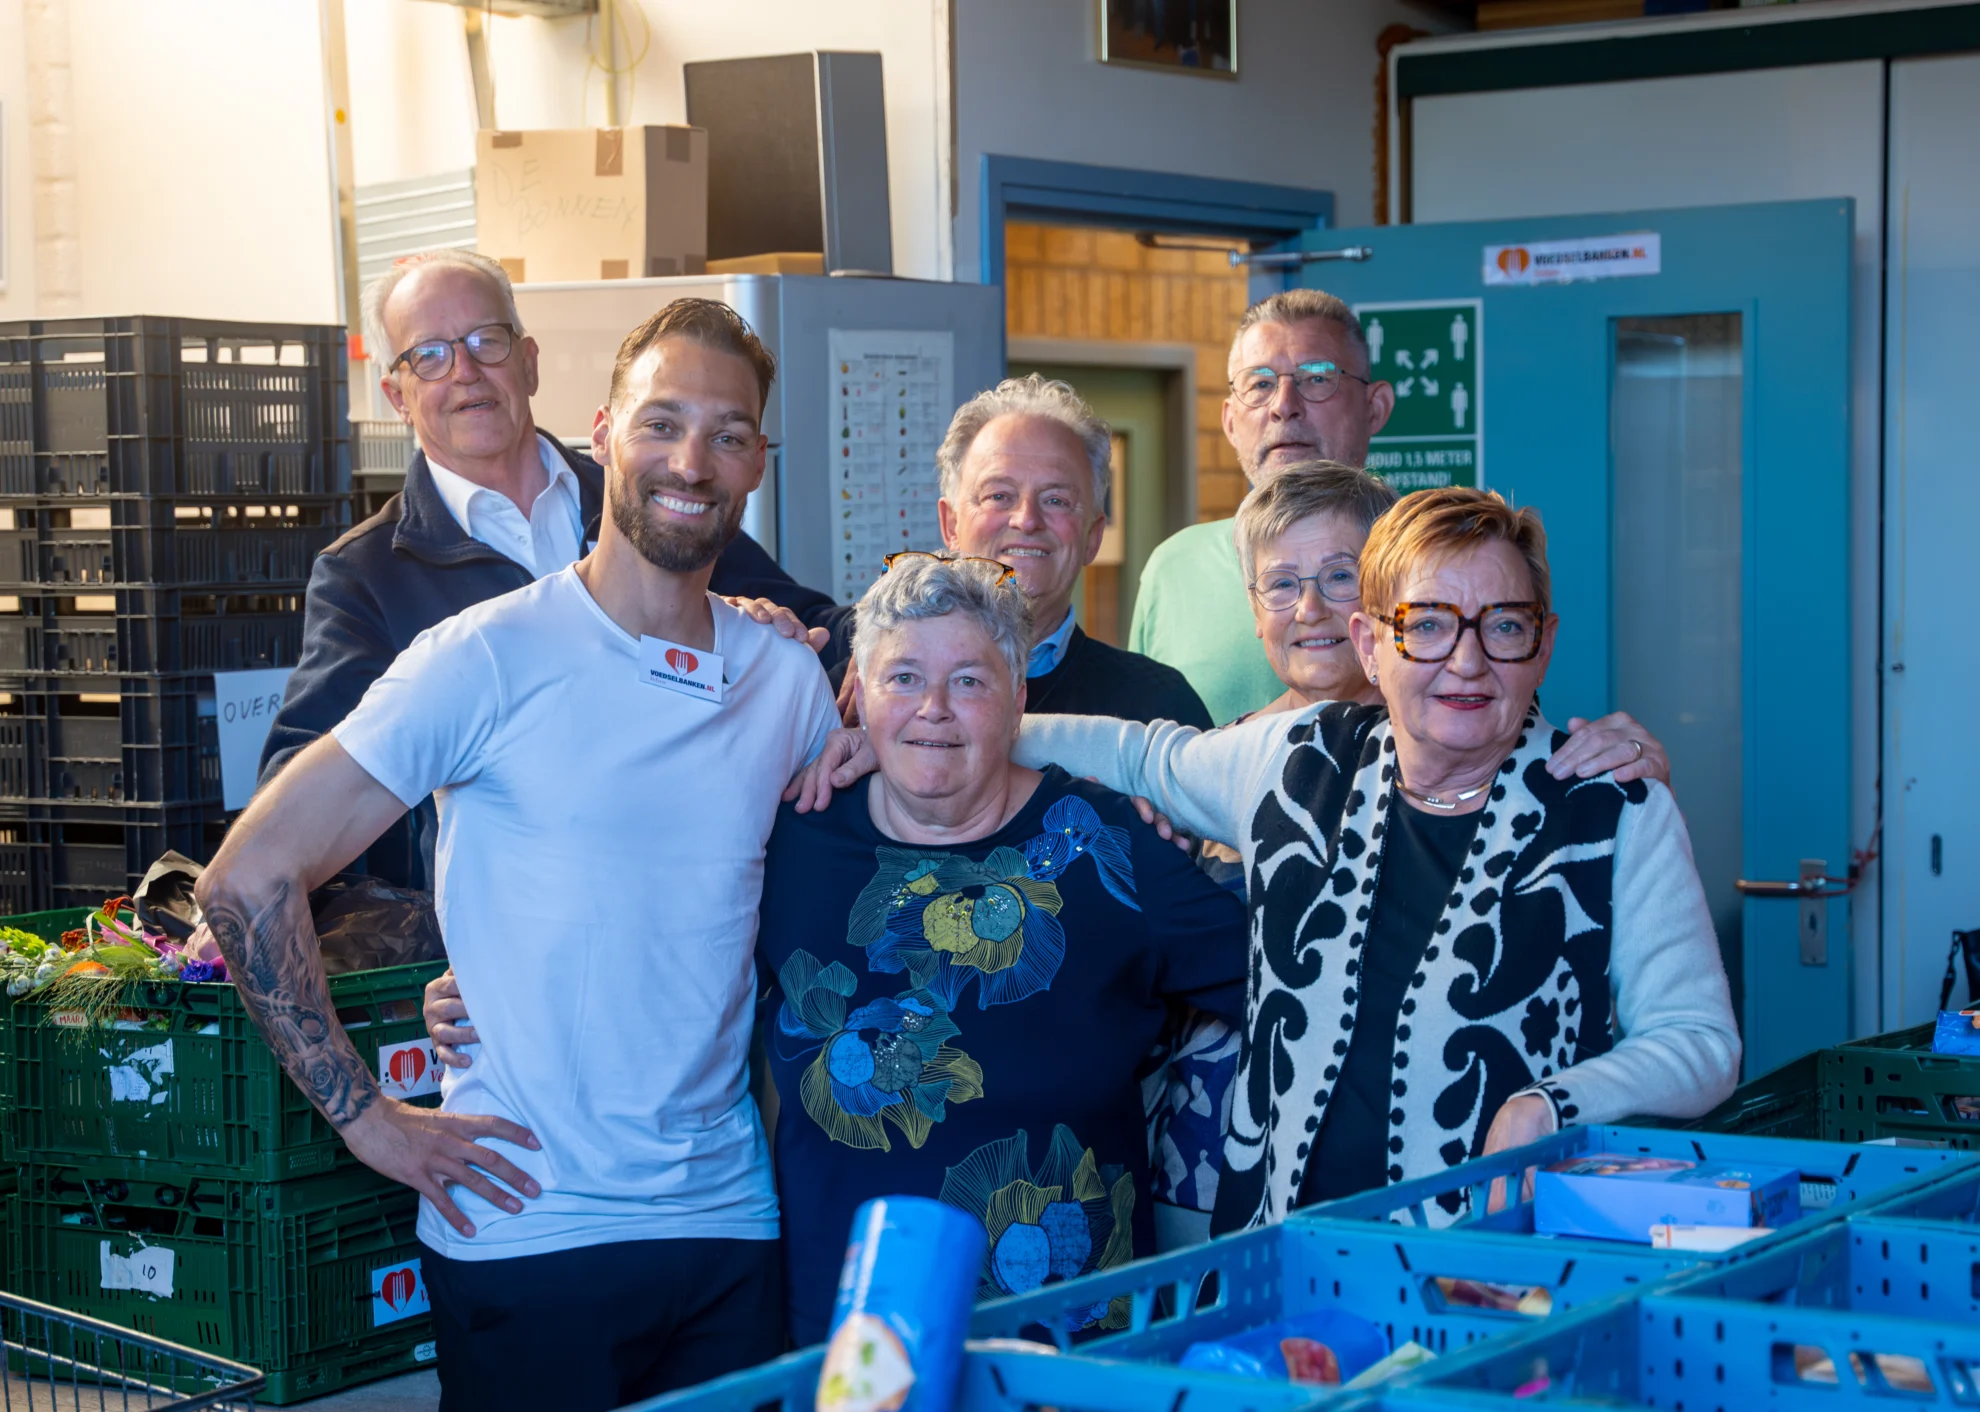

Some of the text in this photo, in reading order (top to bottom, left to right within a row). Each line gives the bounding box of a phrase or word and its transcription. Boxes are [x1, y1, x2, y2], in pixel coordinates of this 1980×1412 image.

[490, 158, 542, 207] DE
[1425, 449, 1473, 467] METER
[650, 669, 715, 693] VOEDSELBANKEN.NL
[223, 692, 281, 724] OVER
[142, 1263, 157, 1281] 10
